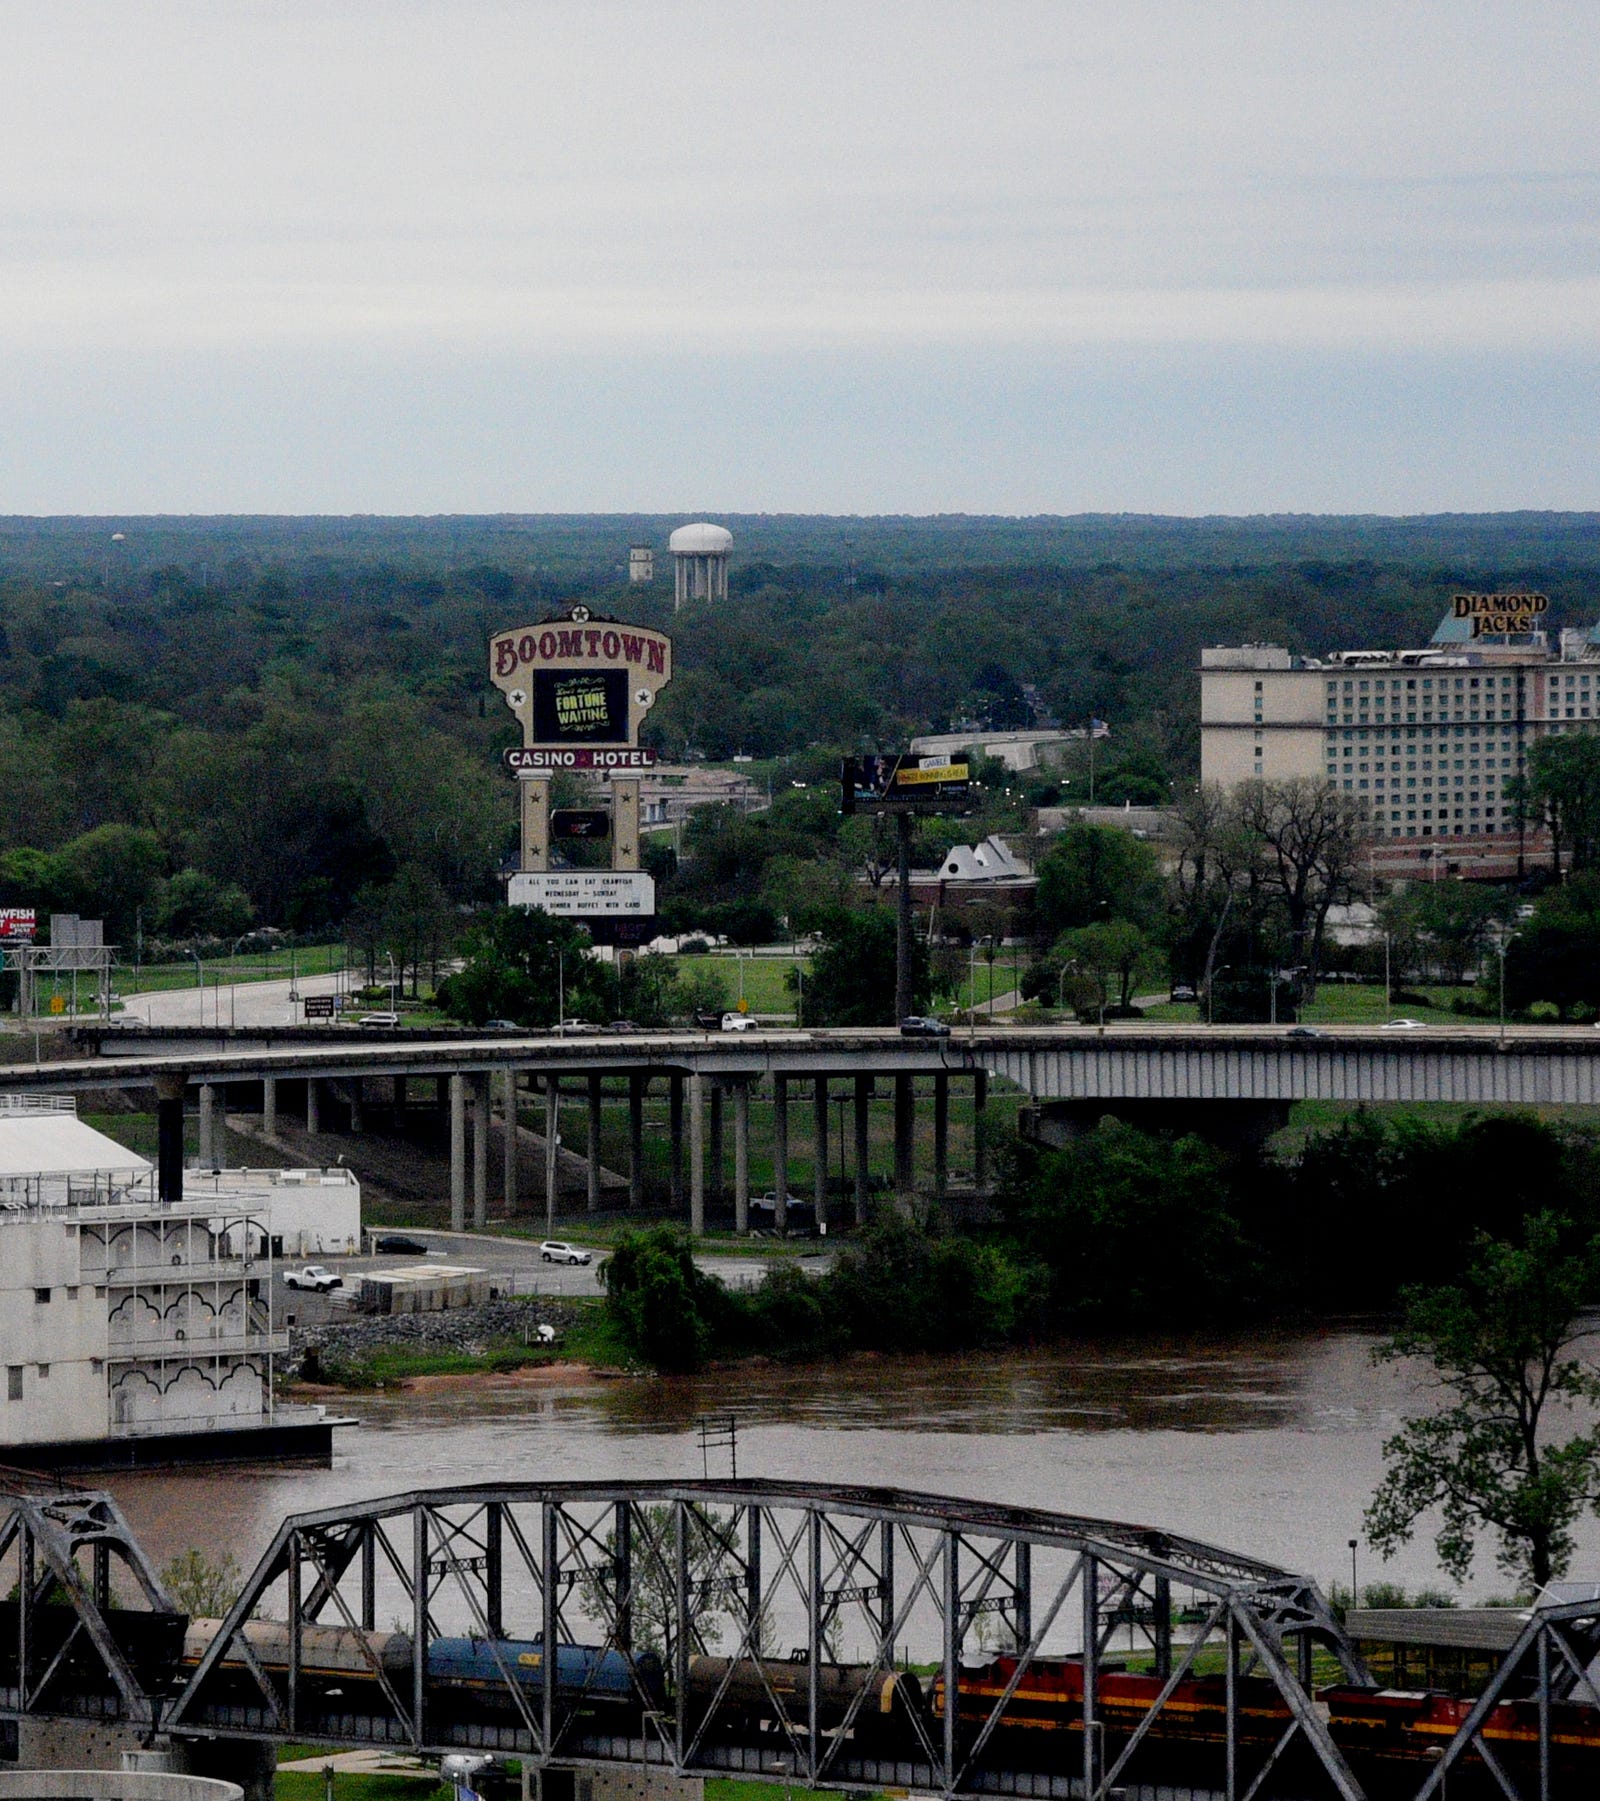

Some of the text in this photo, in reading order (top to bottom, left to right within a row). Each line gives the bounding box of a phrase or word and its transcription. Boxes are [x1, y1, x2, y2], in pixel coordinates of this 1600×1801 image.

[1454, 595, 1547, 618] DIAMOND
[1471, 616, 1531, 638] JACKS
[495, 630, 666, 677] BOOMTOWN
[555, 692, 607, 711] FORTUNE
[557, 707, 608, 724] WAITING
[508, 752, 653, 766] CASINO HOTEL
